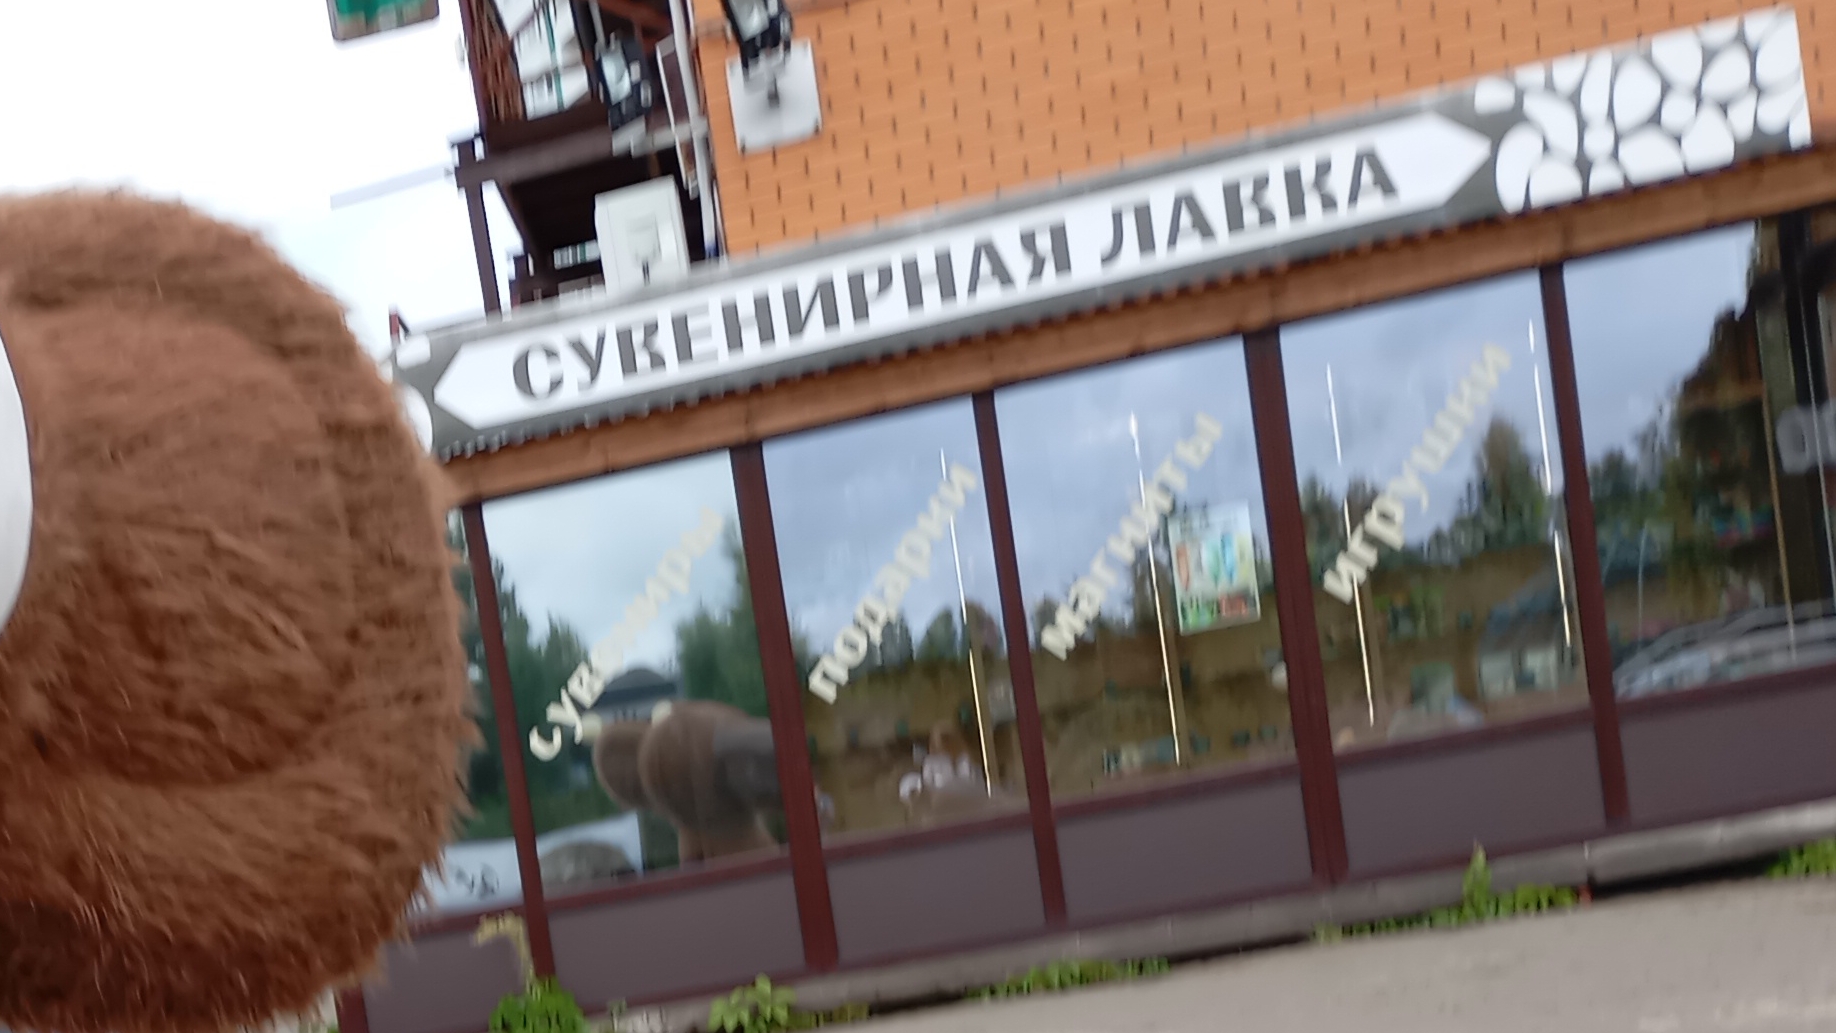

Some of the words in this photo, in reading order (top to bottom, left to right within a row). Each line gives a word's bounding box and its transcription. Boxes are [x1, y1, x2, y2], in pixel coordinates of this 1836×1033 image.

[513, 224, 1073, 400] СУВЕНИРНАЯ
[1100, 146, 1399, 262] ЛАВКА
[809, 462, 977, 705] подарки
[1041, 411, 1223, 661] магниты
[1323, 342, 1511, 604] игрушки
[529, 505, 723, 761] сувениры
